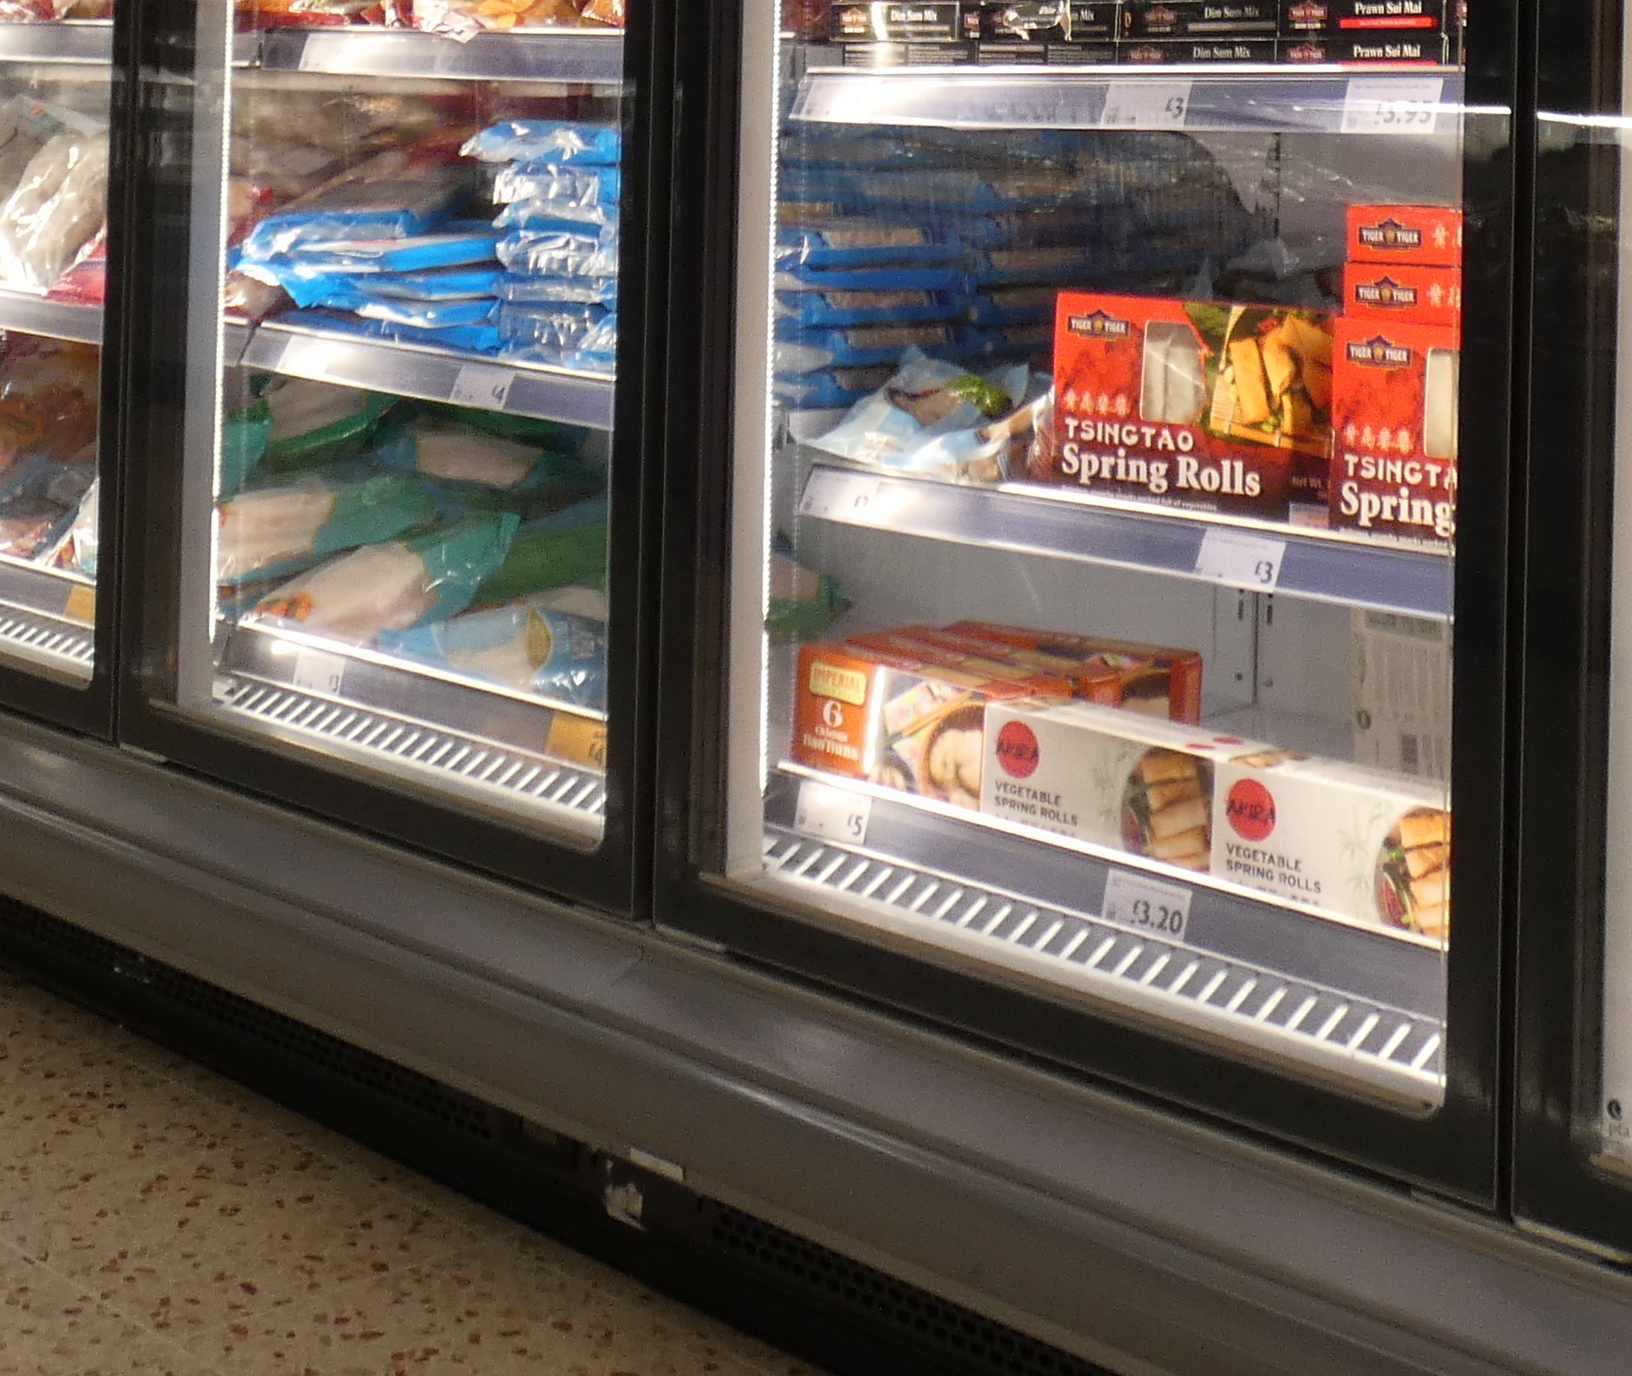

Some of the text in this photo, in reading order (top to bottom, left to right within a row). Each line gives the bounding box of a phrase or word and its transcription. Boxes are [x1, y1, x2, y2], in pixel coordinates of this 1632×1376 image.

[1204, 6, 1260, 19] Dim Sum Mix
[1355, 0, 1422, 15] Prawn Sui Mai
[1193, 46, 1252, 59] Dim Sum Mix
[1353, 44, 1421, 59] Prawn Sui Mai
[1165, 97, 1184, 116] £3
[1362, 229, 1420, 245] TIGER TIGER
[1358, 287, 1416, 303] TIGER TIGER
[1070, 319, 1127, 333] TIGER TIGER
[1349, 345, 1408, 363] TIGER TIGER
[1064, 417, 1194, 452] TSINGTAO
[1061, 442, 1262, 497] Spring Rolls
[1343, 453, 1458, 491] TSINGTA
[1340, 481, 1456, 538] Spring
[1255, 560, 1274, 584] £3
[822, 699, 844, 728] 6
[995, 780, 1063, 806] VEGETABLE
[994, 795, 1078, 827] SPRING ROLLS
[847, 813, 864, 837] £5
[1226, 842, 1302, 873] VEGETABLE
[1225, 858, 1322, 895] SPRING ROLLS
[1132, 898, 1184, 935] £3.20
